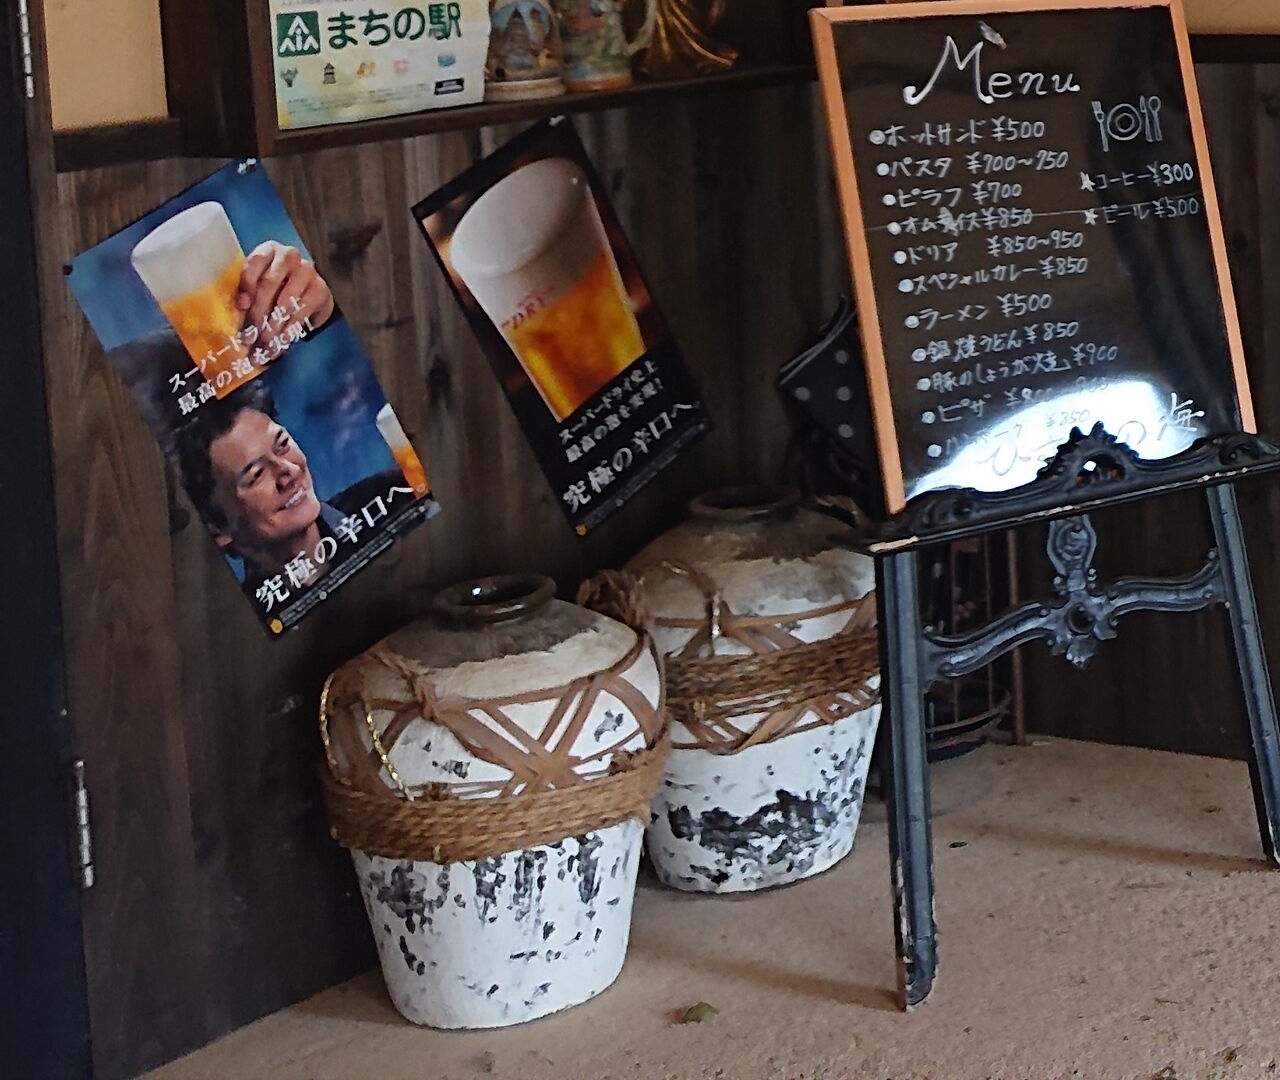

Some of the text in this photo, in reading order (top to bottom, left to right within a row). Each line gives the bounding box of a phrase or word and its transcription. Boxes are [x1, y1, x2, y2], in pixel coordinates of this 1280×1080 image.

[327, 2, 462, 50] まちの駅
[903, 35, 1080, 105] Menu
[992, 116, 1045, 143] ¥500
[889, 157, 952, 178] パスタ
[1146, 161, 1194, 187] ¥300
[898, 180, 1022, 208] ピラフ ¥700
[907, 242, 958, 265] ドリア
[919, 293, 1052, 331] ラーメン ¥500
[168, 296, 306, 393] スーパードライ史上
[1024, 321, 1080, 345] ¥850
